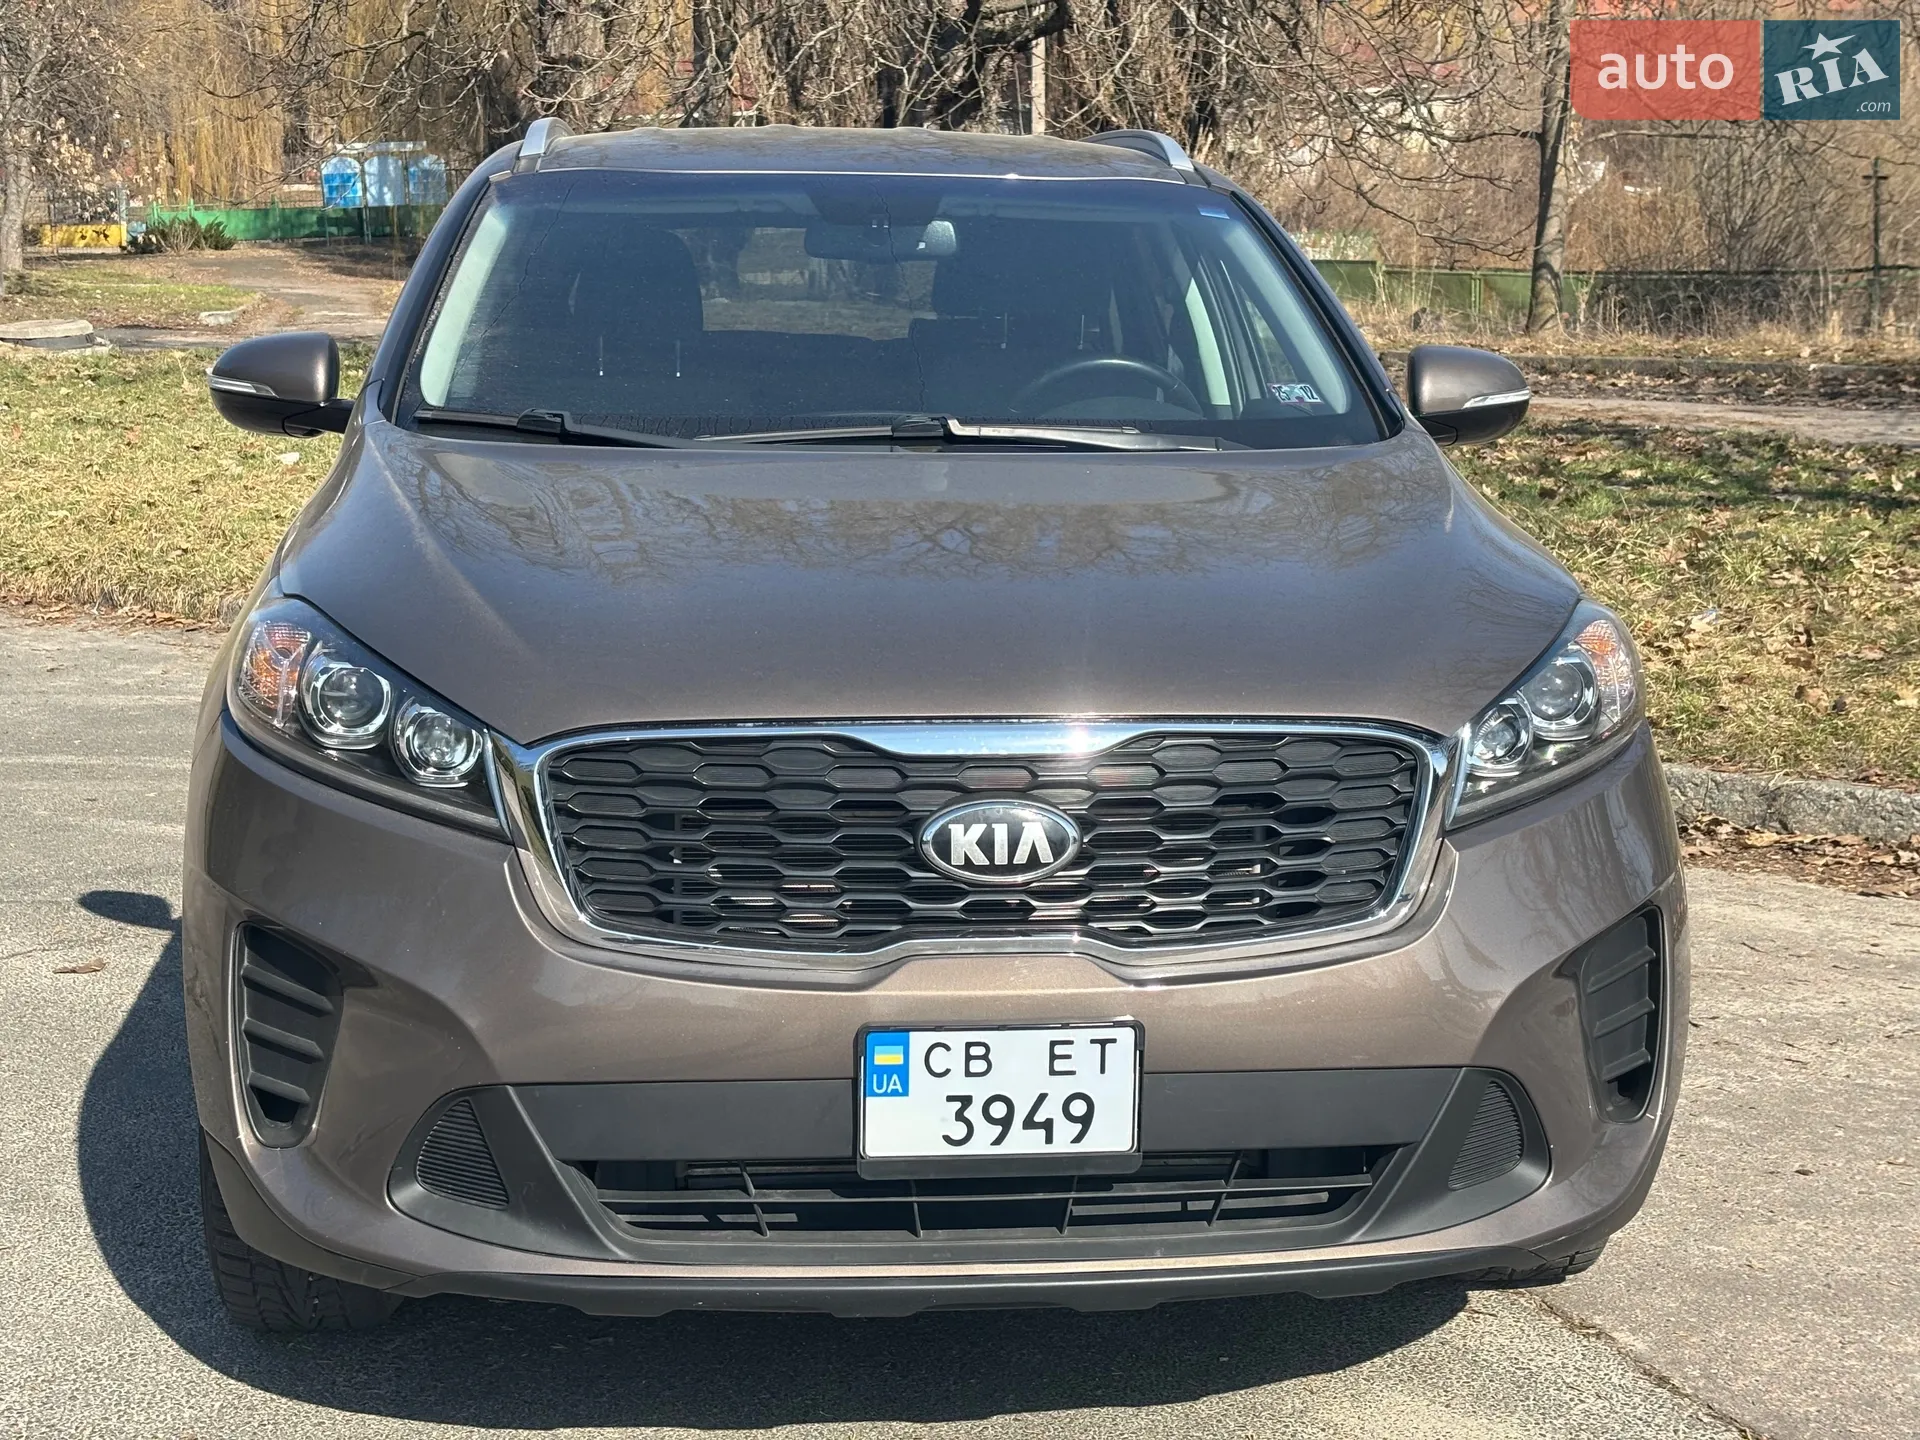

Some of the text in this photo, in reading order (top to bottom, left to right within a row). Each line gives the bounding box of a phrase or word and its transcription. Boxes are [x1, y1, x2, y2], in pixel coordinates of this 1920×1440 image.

[1299, 385, 1319, 400] 12
[948, 821, 1054, 866] KIA
[923, 1037, 1118, 1078] CB ET
[872, 1073, 903, 1094] UA
[942, 1092, 1095, 1147] 3949
